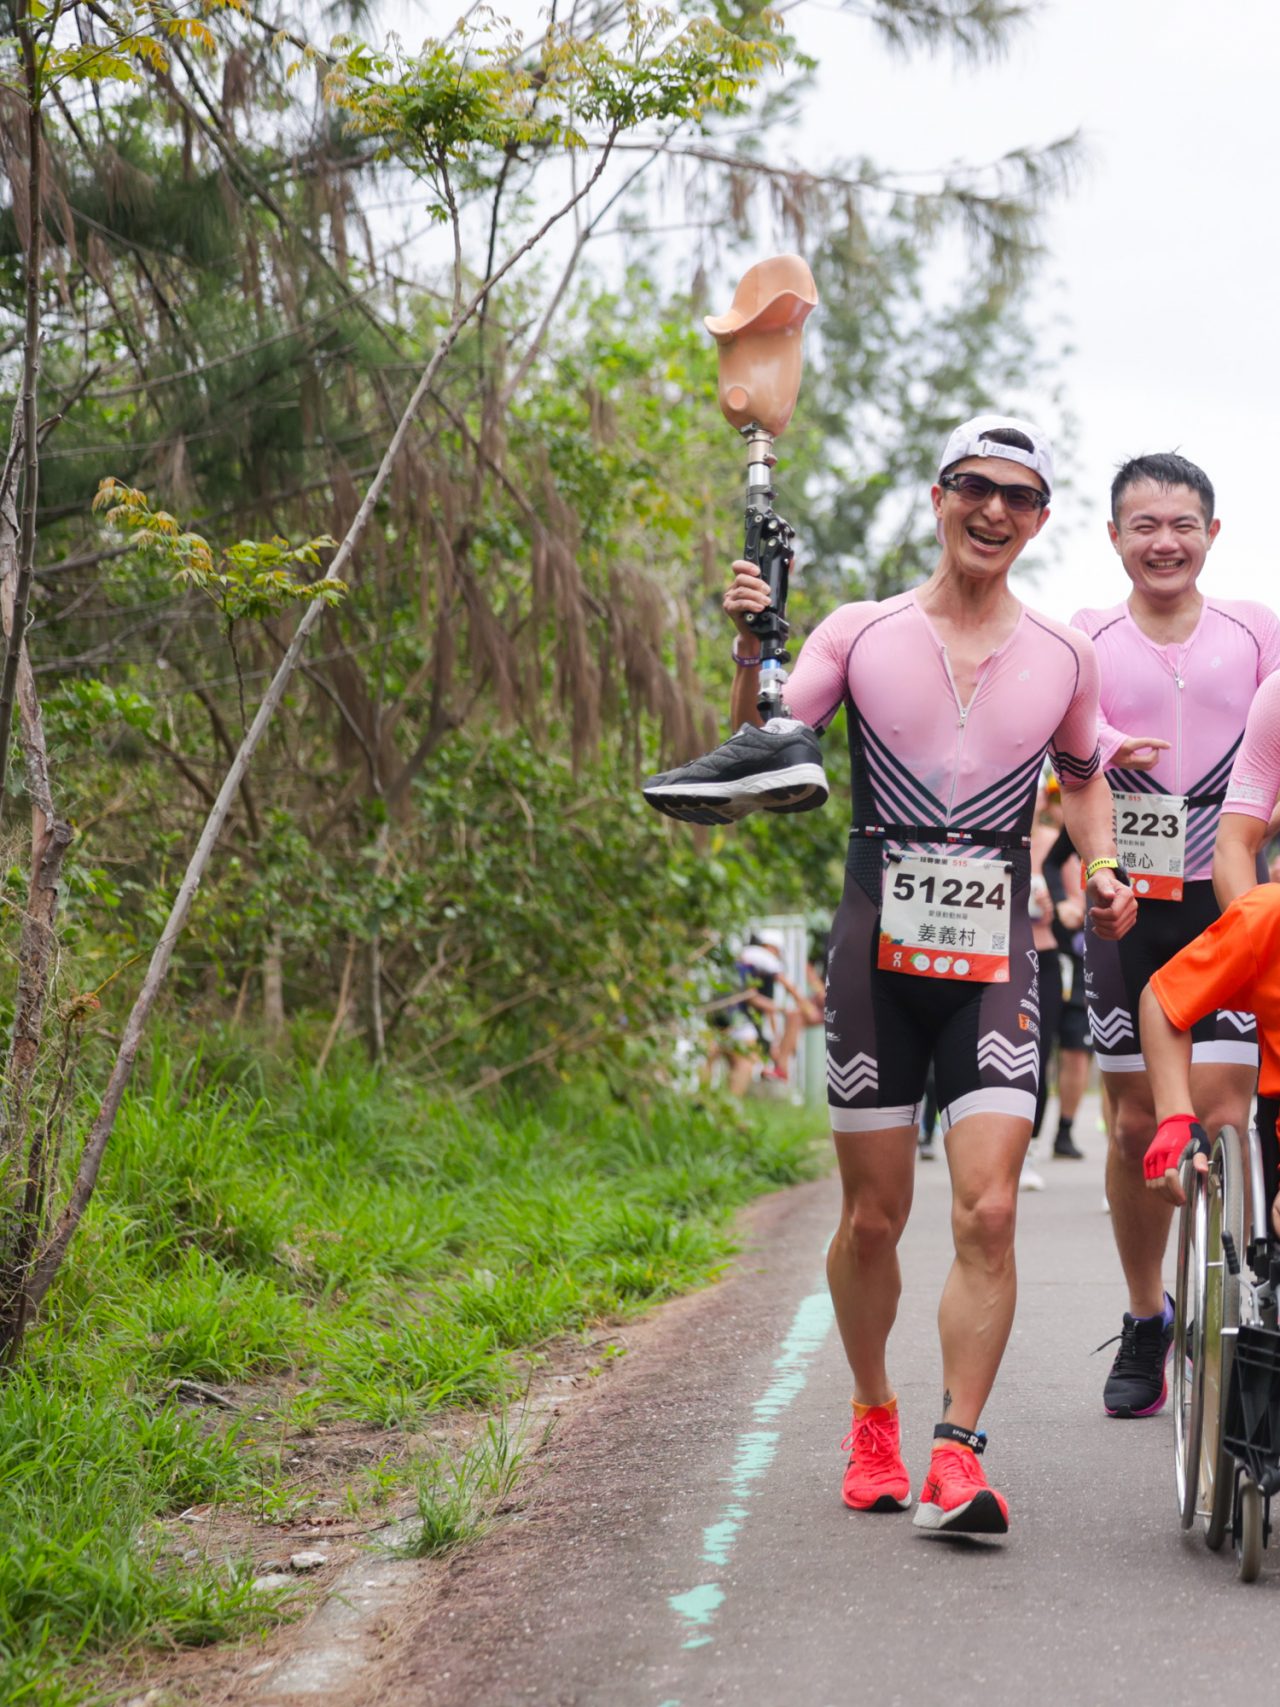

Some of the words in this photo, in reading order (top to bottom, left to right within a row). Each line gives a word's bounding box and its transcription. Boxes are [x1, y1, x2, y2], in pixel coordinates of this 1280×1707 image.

[1121, 811, 1179, 838] 223
[953, 859, 968, 867] 515
[892, 873, 1006, 910] 51224
[917, 923, 977, 947] 姜義村
